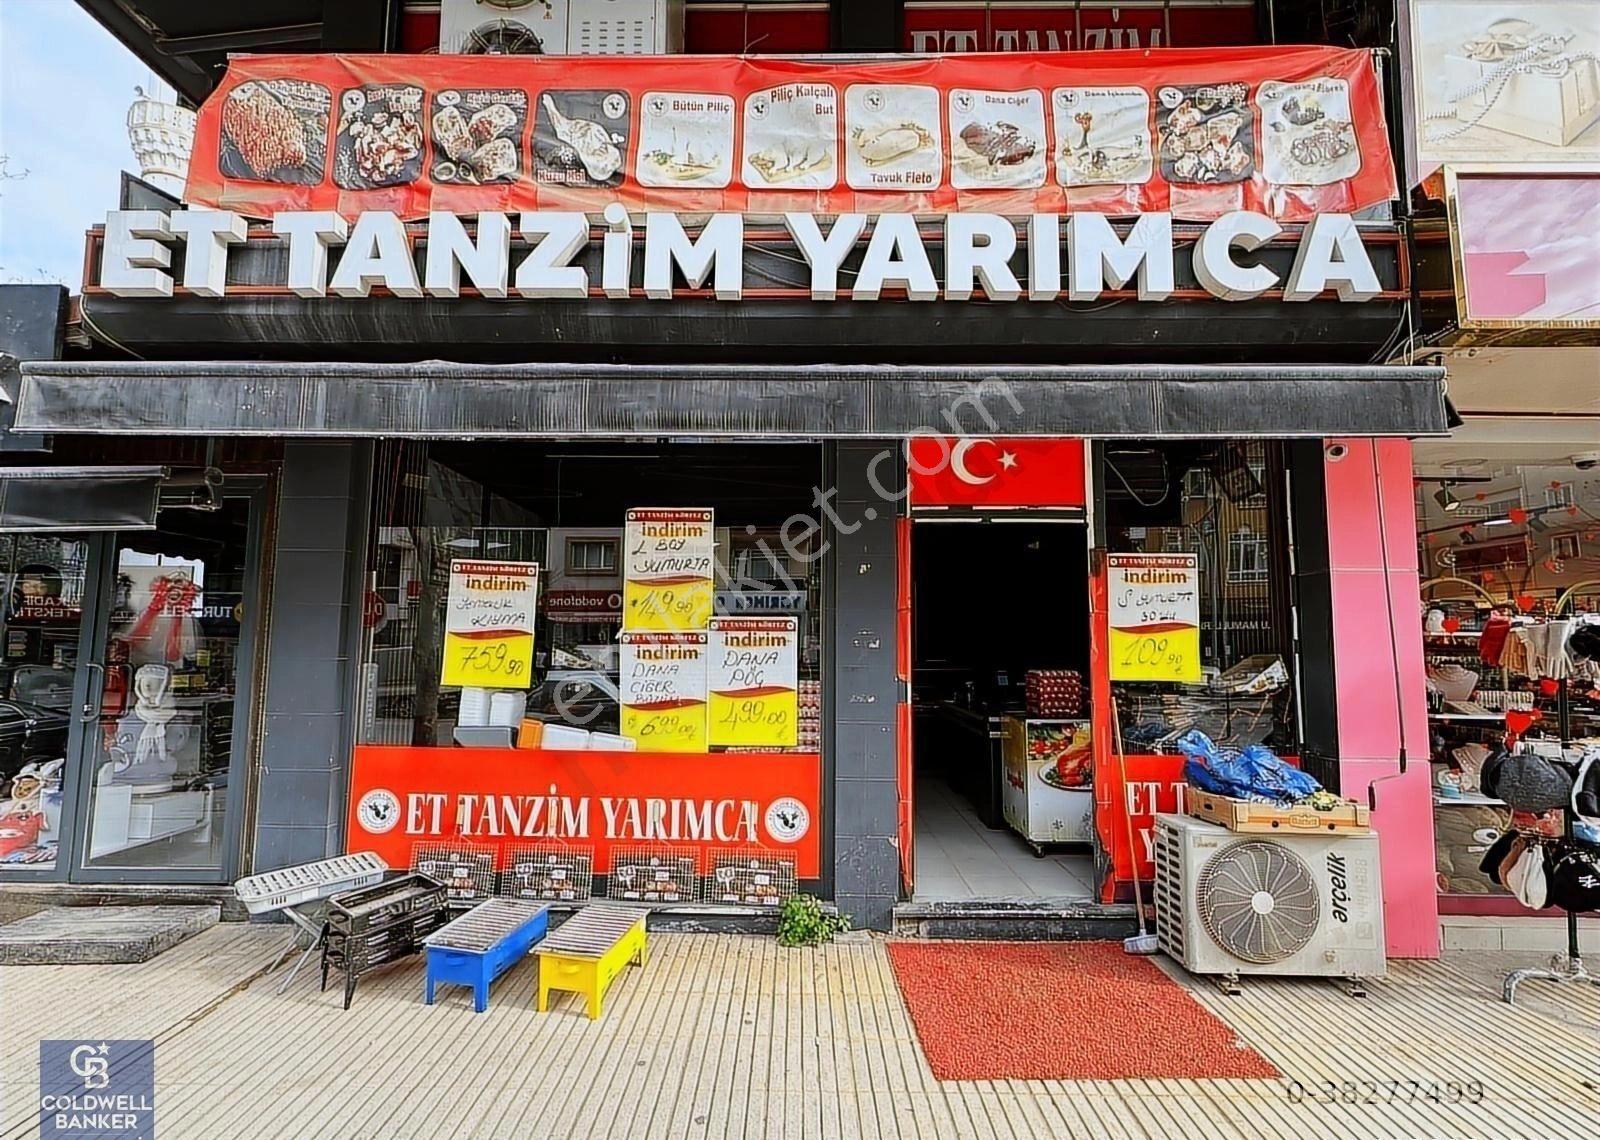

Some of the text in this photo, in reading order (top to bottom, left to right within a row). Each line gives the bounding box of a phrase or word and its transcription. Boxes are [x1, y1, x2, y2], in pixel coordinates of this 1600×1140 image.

[771, 85, 834, 104] Piliç Kalçalı
[706, 100, 730, 114] Piliç
[815, 103, 834, 116] But
[871, 172, 903, 184] Tavuk
[100, 209, 248, 298] ET
[272, 202, 743, 300] TANZİM
[642, 522, 703, 537] indirim
[465, 574, 527, 592] indirim
[1124, 568, 1187, 584] indirim
[724, 632, 787, 647] indirim
[460, 643, 524, 676] 759 90
[637, 645, 699, 660] indirim
[722, 651, 779, 669] DANA
[1121, 636, 1169, 666] 109
[631, 663, 680, 678] DANA
[1126, 781, 1161, 816] ET
[404, 792, 448, 835] ET
[459, 783, 590, 838] TANZİM
[600, 797, 758, 842] YARIMCA
[1326, 852, 1351, 923] arçelik
